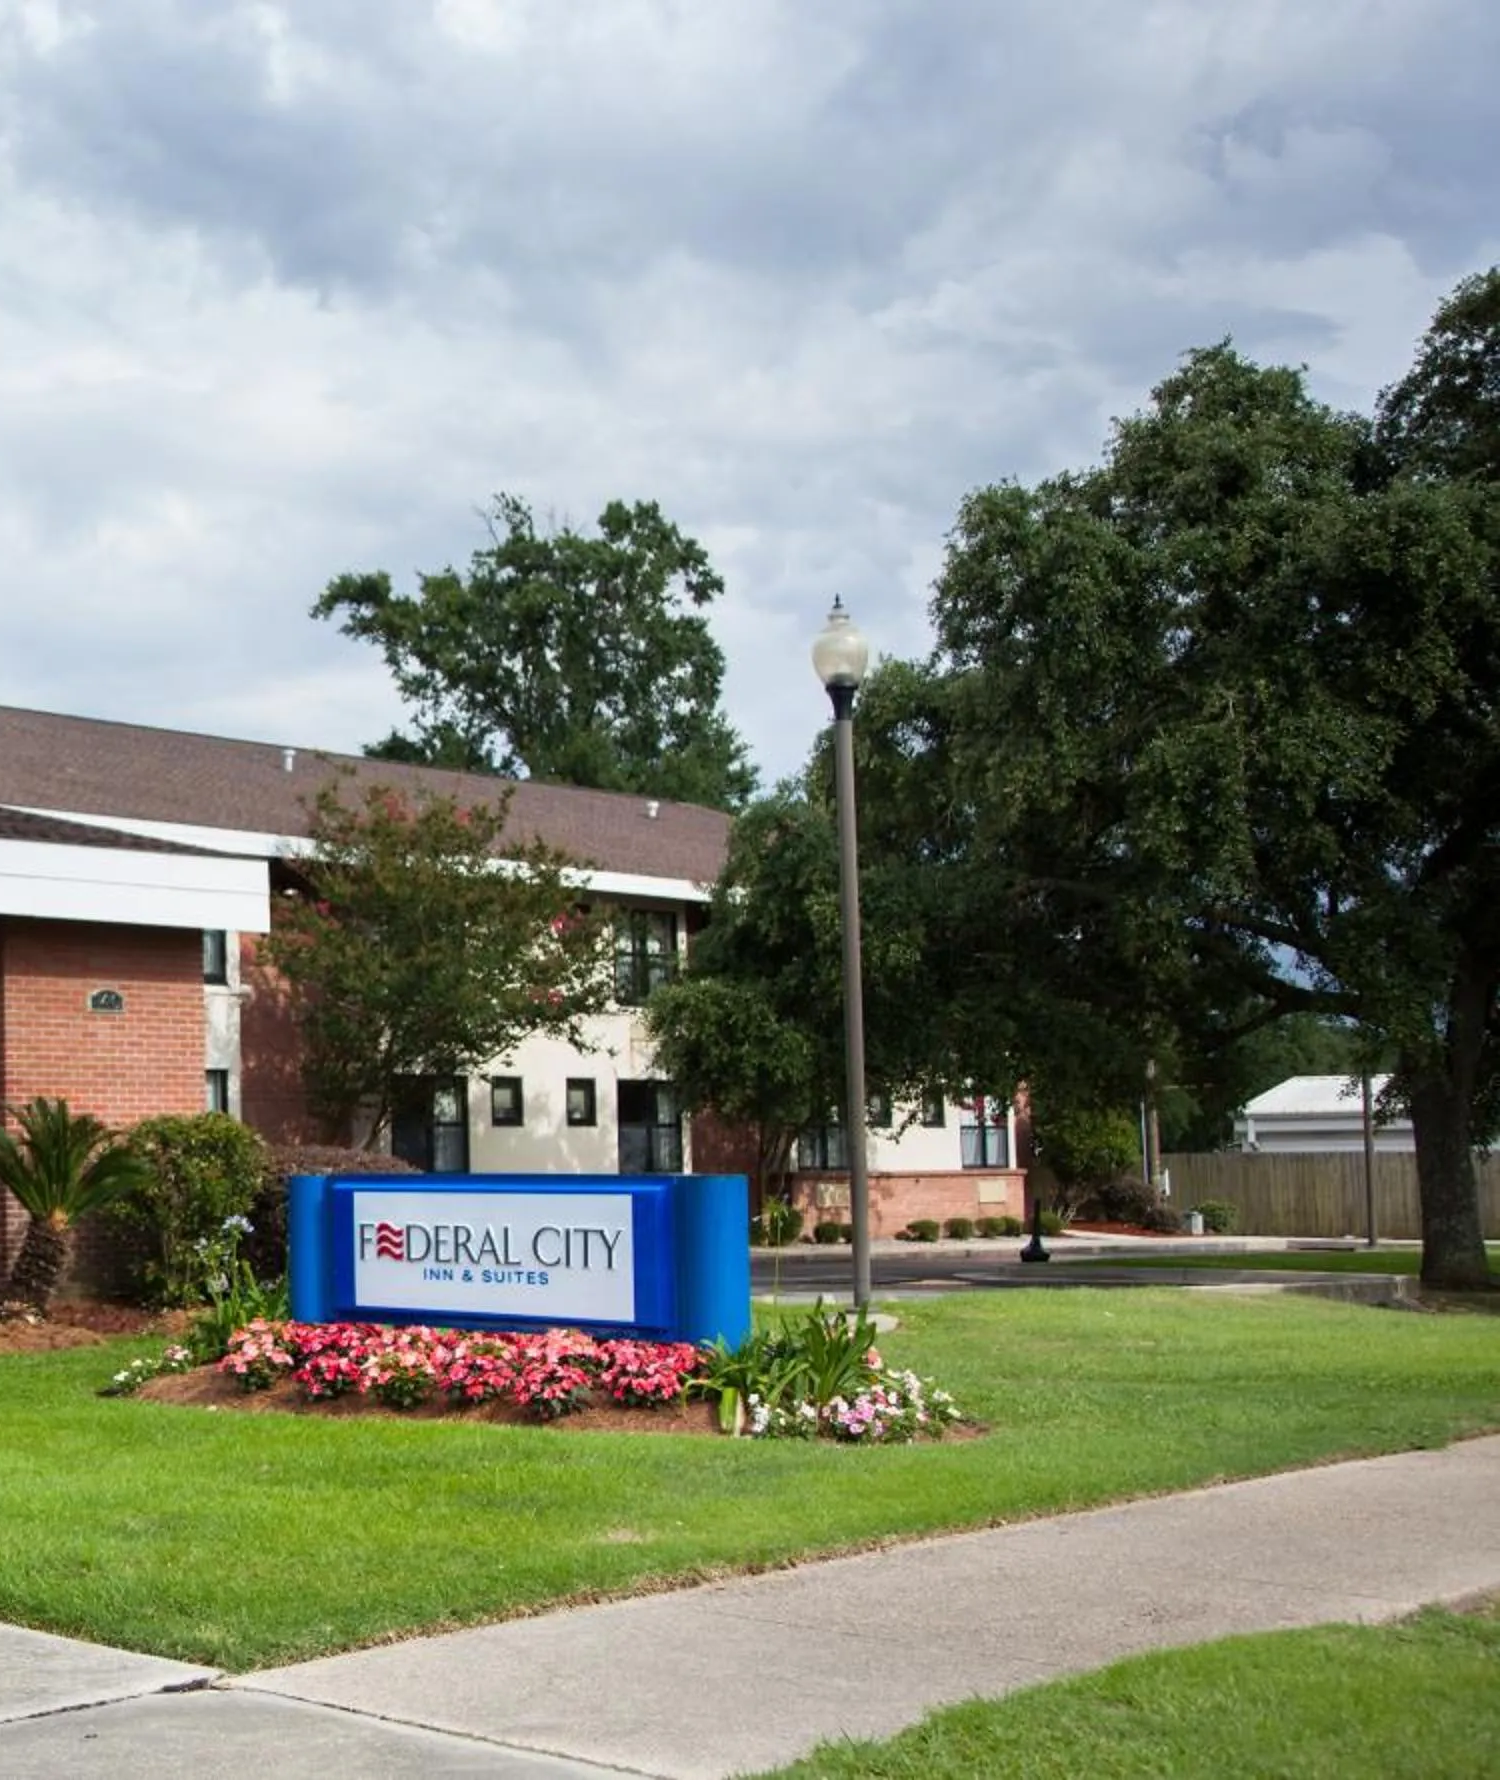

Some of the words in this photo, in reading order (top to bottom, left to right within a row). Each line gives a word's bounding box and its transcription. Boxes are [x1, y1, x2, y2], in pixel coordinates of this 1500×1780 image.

[359, 1222, 521, 1266] FEDERAL
[532, 1225, 623, 1270] CITY
[423, 1267, 453, 1281] INN
[462, 1269, 473, 1282] &
[482, 1270, 549, 1285] SUITES
